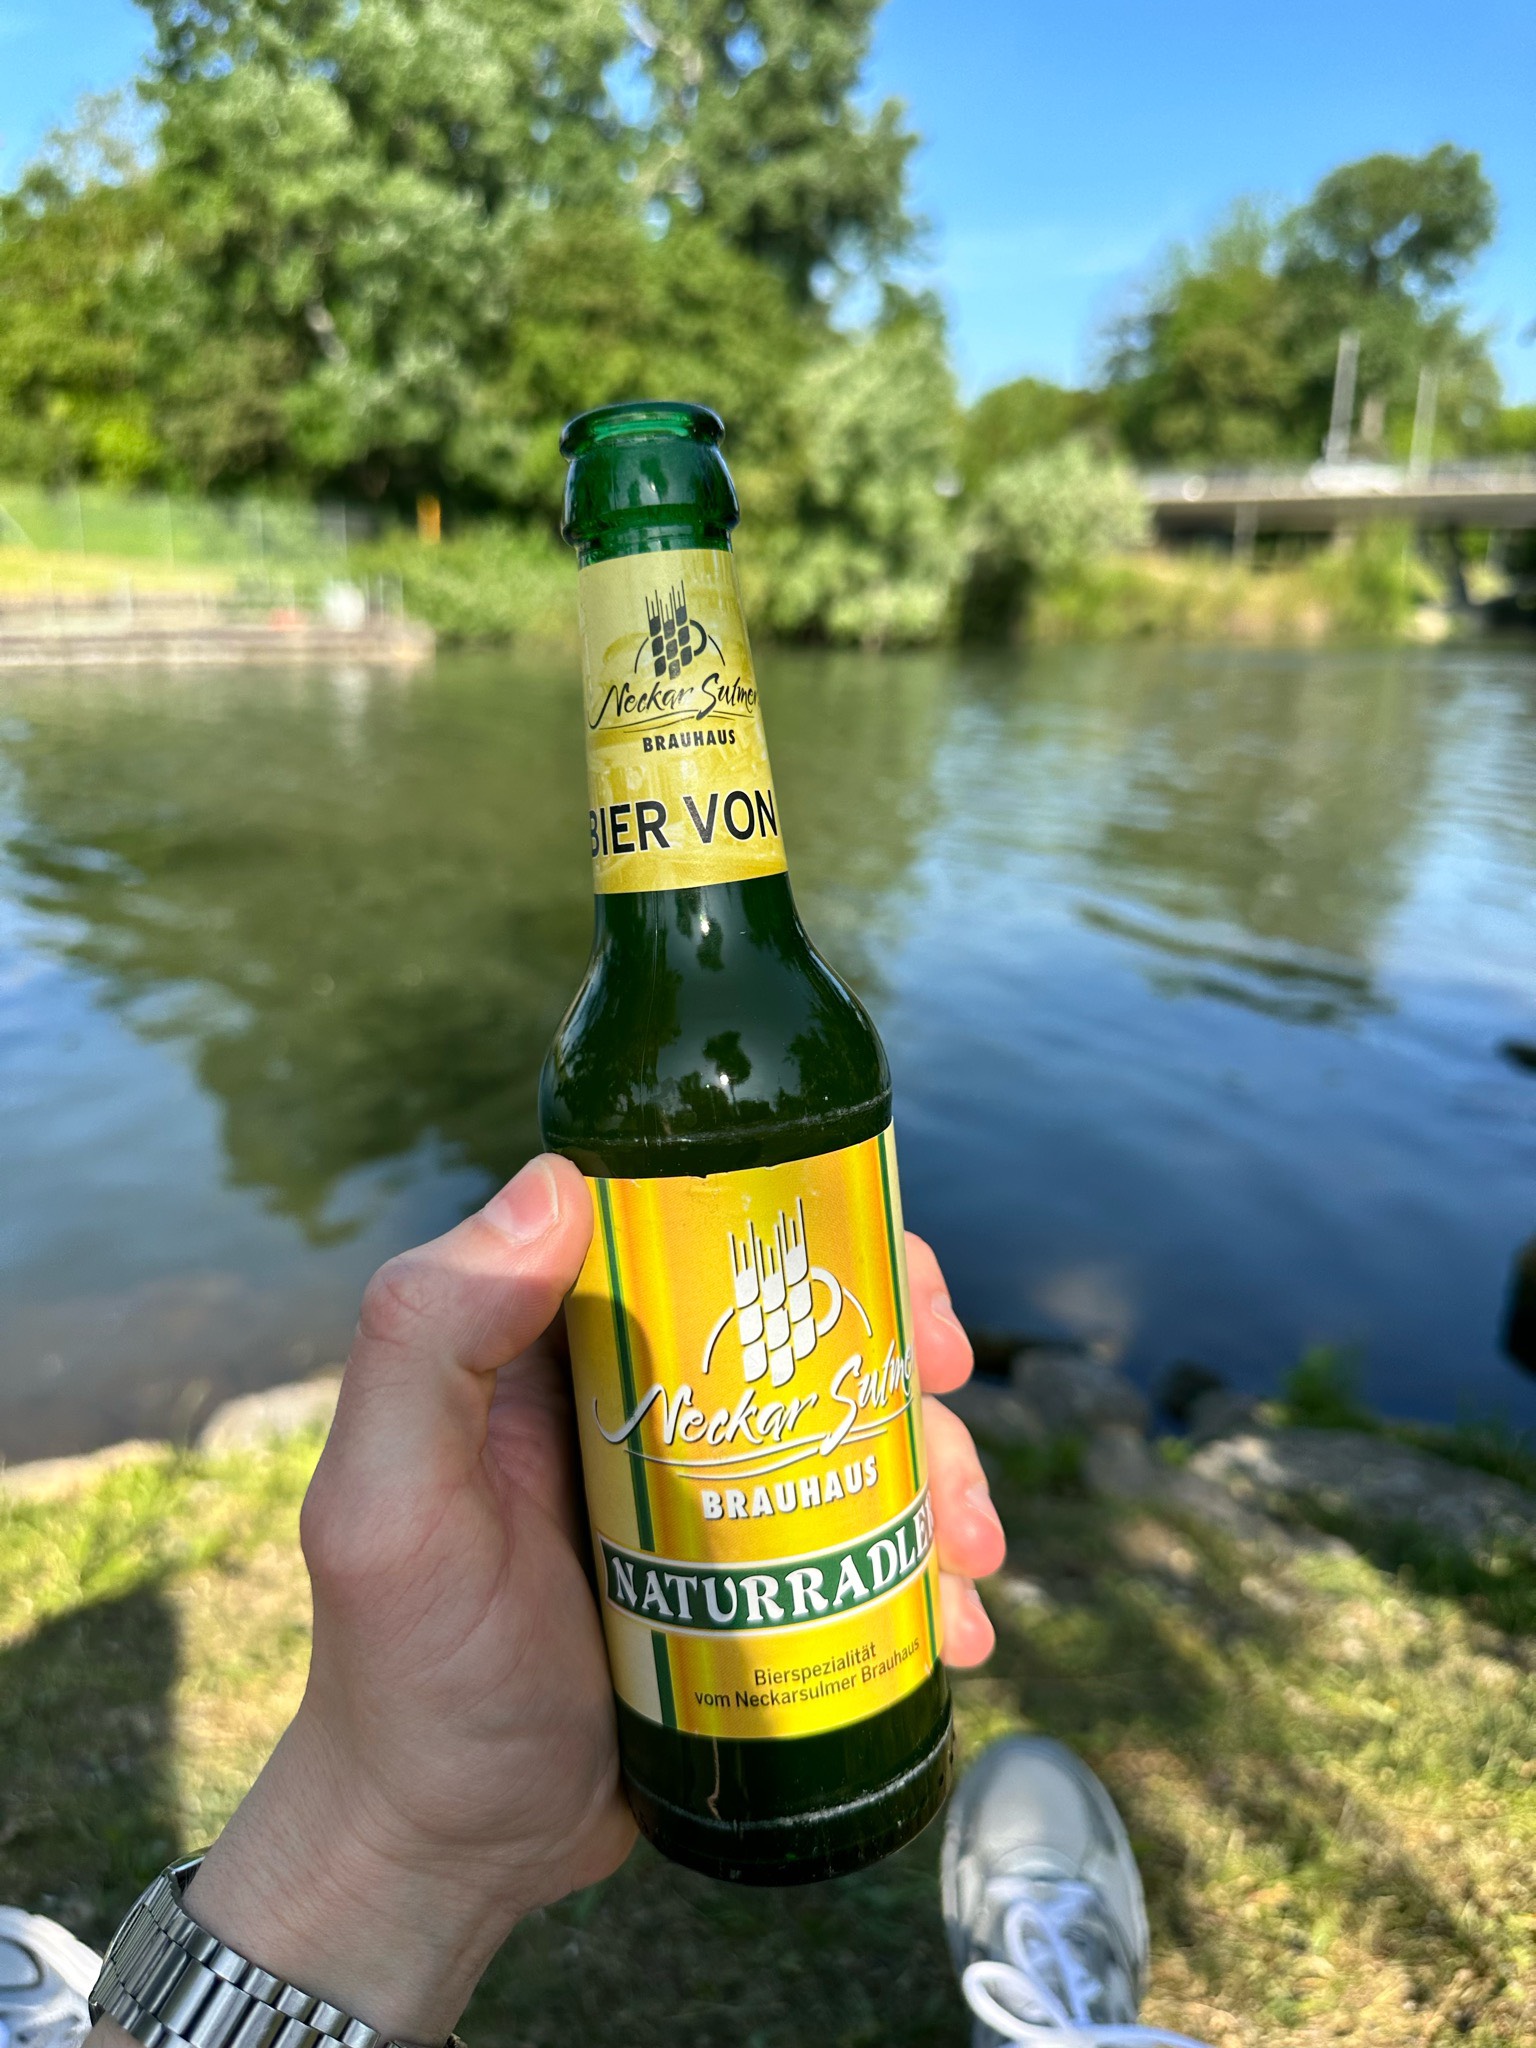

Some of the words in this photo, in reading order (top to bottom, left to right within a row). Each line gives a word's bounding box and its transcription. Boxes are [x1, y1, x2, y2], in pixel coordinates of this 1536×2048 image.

[589, 678, 694, 730] Neckar
[642, 729, 736, 753] BRAUHAUS
[589, 800, 671, 858] BIER
[683, 789, 779, 844] VON
[592, 1382, 820, 1446] Neckar
[819, 1338, 914, 1457] Sulme
[701, 1454, 879, 1520] BRAUHAUS
[694, 1692, 731, 1708] vom
[735, 1673, 857, 1708] Neckarsulmer
[861, 1636, 921, 1684] Brauhaus
[754, 1641, 877, 1686] Bierspezialität
